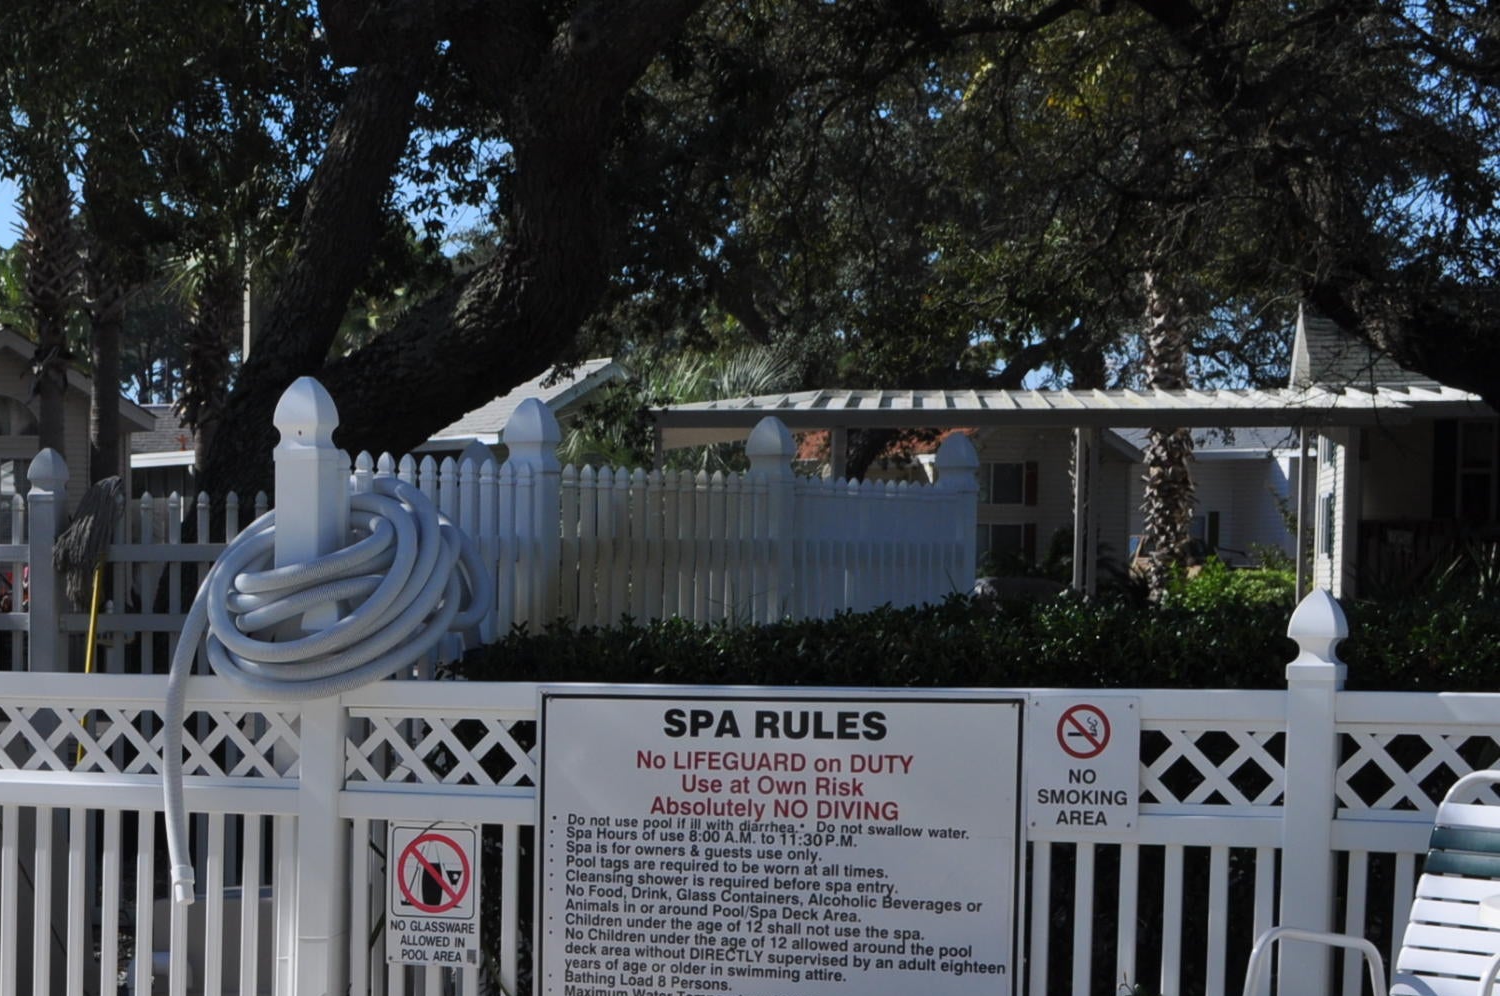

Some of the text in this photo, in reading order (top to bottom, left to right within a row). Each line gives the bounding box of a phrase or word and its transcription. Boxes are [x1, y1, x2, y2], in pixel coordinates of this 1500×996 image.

[664, 709, 888, 741] SPA RULES
[637, 750, 914, 775] No LIFEGUARD on DUTY
[682, 774, 865, 797] Use at Own Risk
[1068, 769, 1097, 784] NO
[1037, 788, 1128, 806] SMOKING
[650, 796, 899, 822] Absolutely NO DIVING
[1056, 810, 1108, 826] AREA
[566, 827, 858, 848] Spa Hours of use 8:00 A.M. to 11:30 P.M.
[568, 814, 970, 840] Do not use pool if ill with diarrhea. Do not swallow water.
[566, 842, 822, 865] Spa is for owners & guests use only.
[566, 856, 889, 879] Pool tags are required to be worn at all times.
[566, 871, 899, 897] Cleansing shower is required before spa entry.
[565, 899, 862, 923] Animals in or around Pool/Spa Deck Area.
[566, 885, 983, 914] No Food, Drink, Glass Containers, Alcoholic Beverages or
[391, 920, 475, 934] NO GLASSWARE
[400, 934, 465, 948] ALLOWED IN
[401, 949, 462, 962] POOL AREA
[565, 971, 733, 992] Bathing Load 8 Persons.
